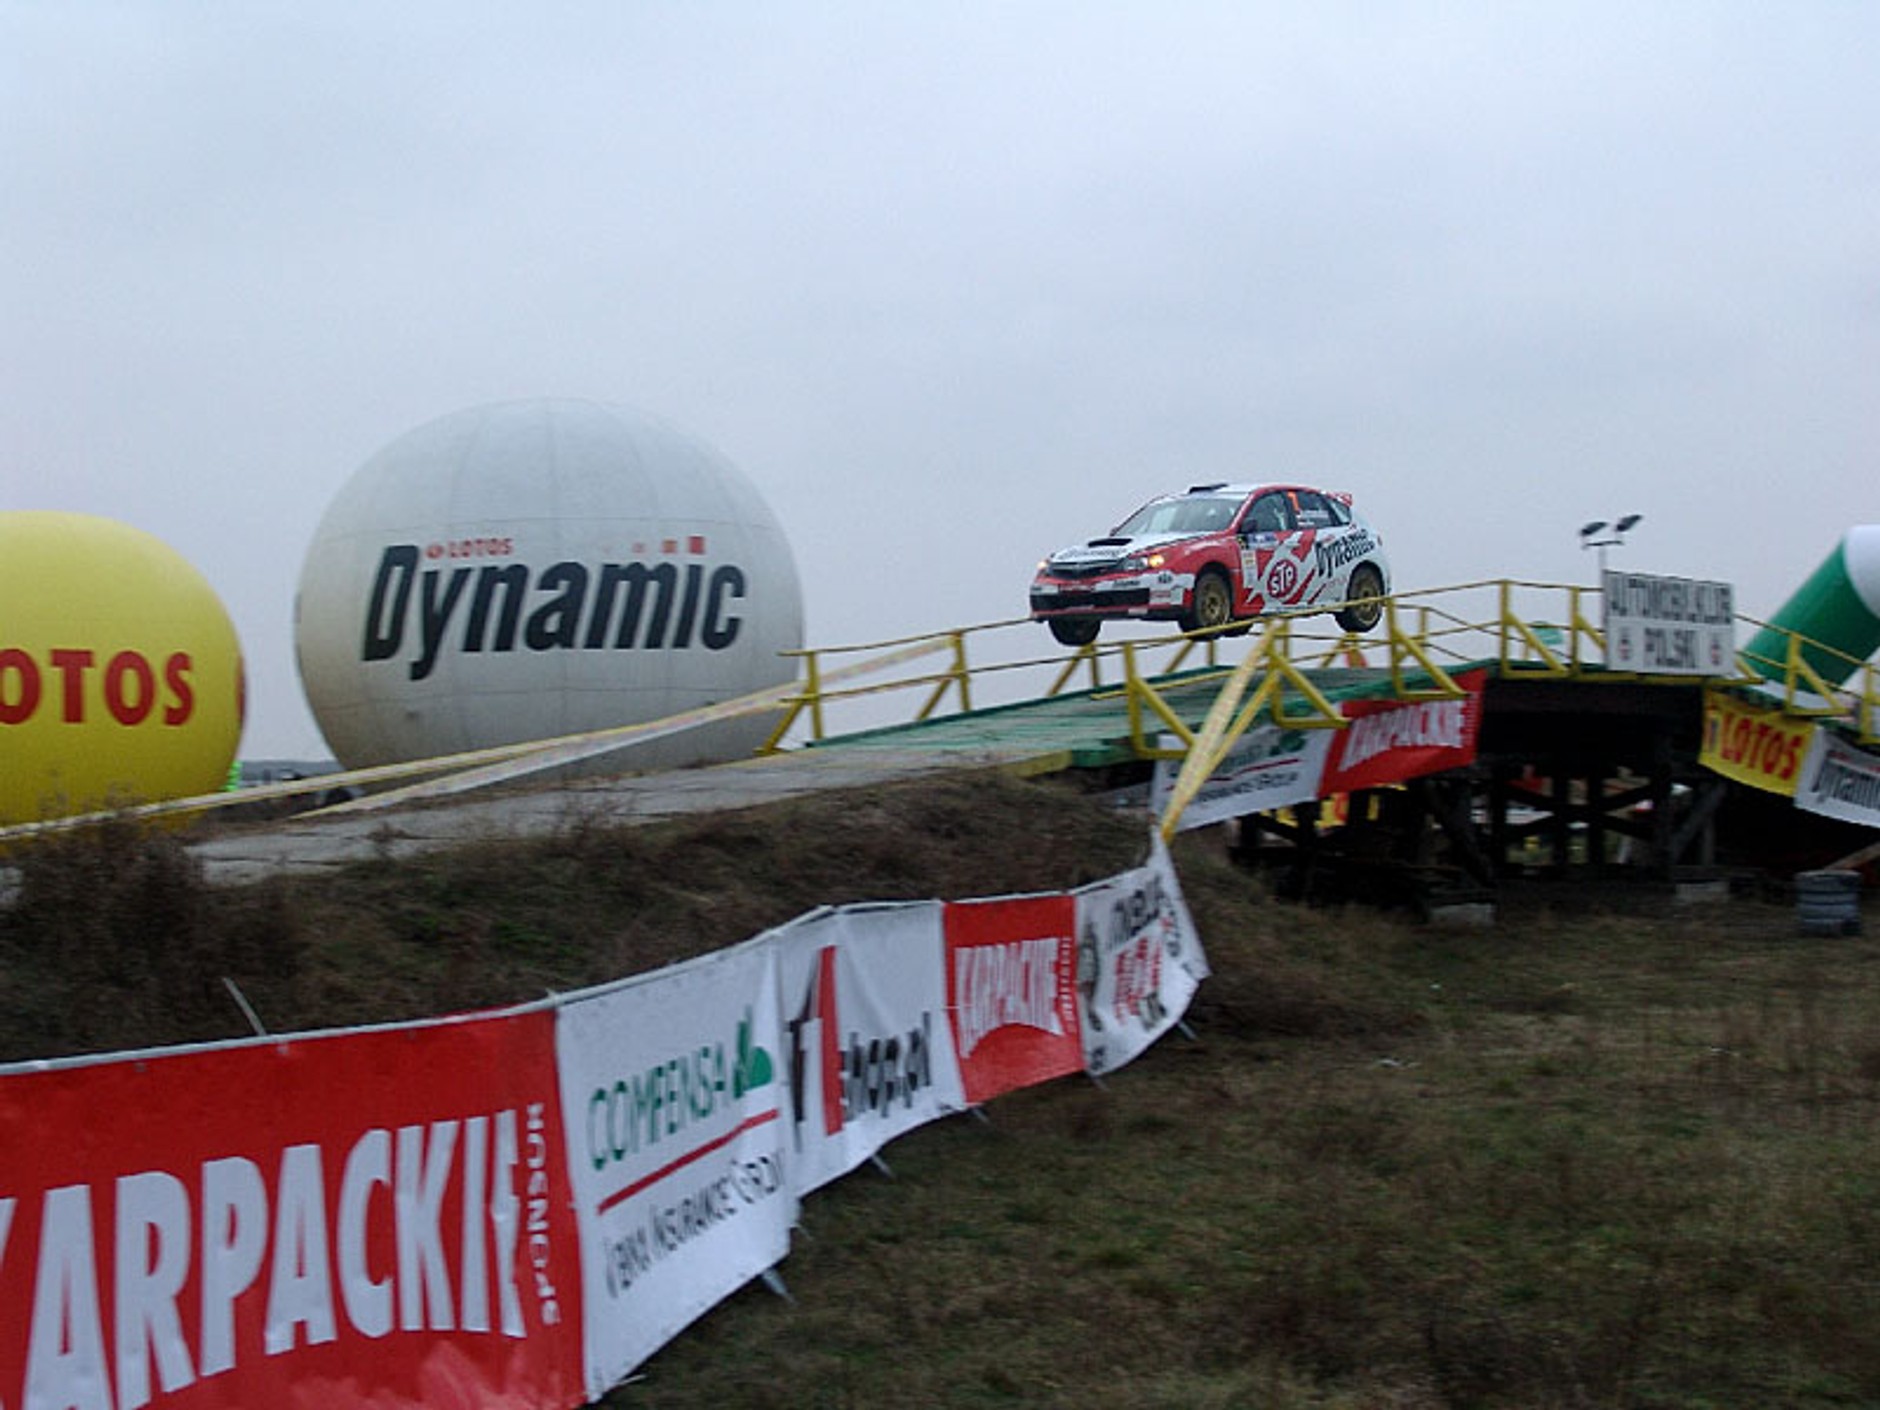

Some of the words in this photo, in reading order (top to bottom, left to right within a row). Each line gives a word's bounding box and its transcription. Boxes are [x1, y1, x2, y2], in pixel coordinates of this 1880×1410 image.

[448, 537, 515, 558] LOTOS
[1269, 561, 1294, 595] STP
[361, 544, 746, 681] Dynamic
[1720, 711, 1805, 782] LOTOS
[0, 1109, 527, 1410] ARPACKIE
